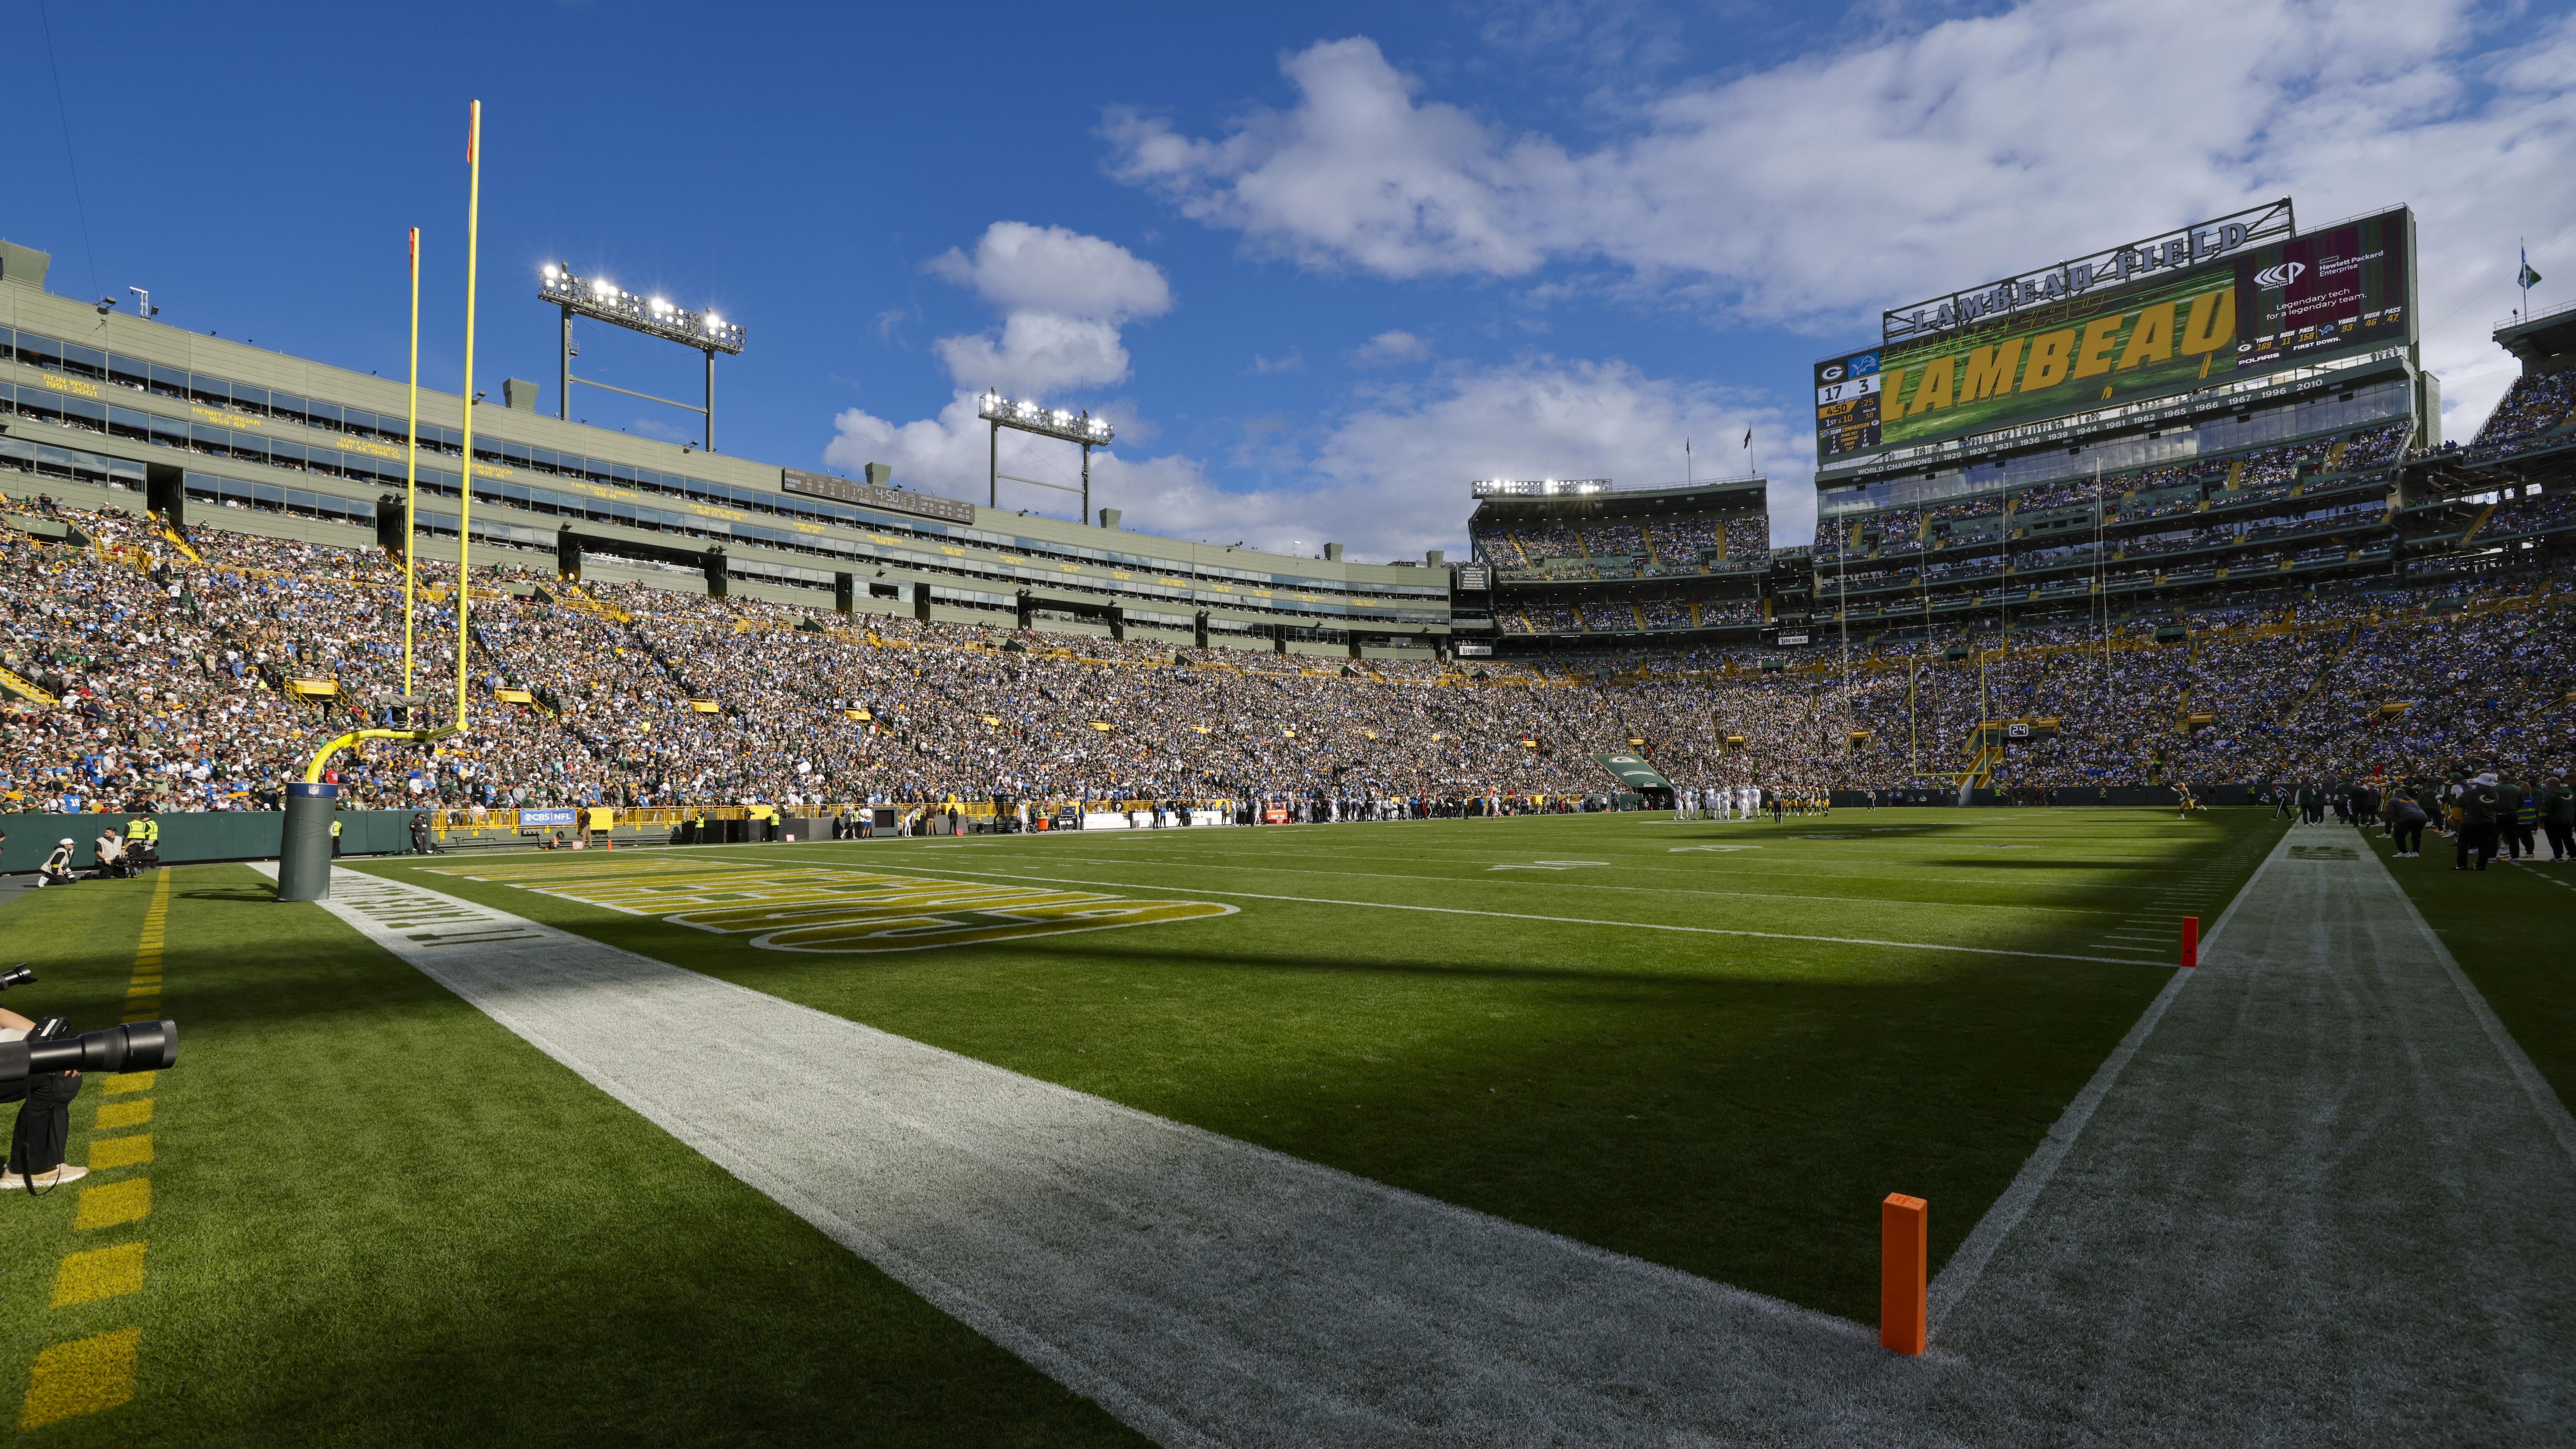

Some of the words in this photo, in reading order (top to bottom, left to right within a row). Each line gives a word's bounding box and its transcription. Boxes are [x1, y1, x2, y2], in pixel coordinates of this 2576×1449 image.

[2319, 259, 2350, 271] Hewlett
[2351, 250, 2383, 263] Packard
[1912, 264, 2093, 334] LAMBEAU
[2114, 223, 2247, 279] FIELD
[2319, 263, 2358, 277] Enterprise
[2277, 293, 2326, 310] Legendary
[2328, 288, 2349, 298] tech
[2289, 299, 2336, 315] legendary
[2339, 294, 2367, 303] team.
[2338, 317, 2358, 325] YARDS
[2342, 324, 2353, 332] 93
[2365, 318, 2377, 327] 46
[2387, 314, 2399, 322] 47
[2256, 335, 2274, 344] YARDS
[2299, 326, 2314, 334] PASS
[2257, 342, 2272, 351] 169
[2298, 333, 2314, 342] 158
[2293, 342, 2314, 350] FIRST
[2316, 337, 2341, 346] DOWN.
[1880, 287, 2236, 422] LAMBEAU
[2238, 353, 2279, 365] POLARIS
[43, 374, 66, 384] RON
[70, 380, 98, 390] WOLF
[1825, 385, 1842, 401] 17
[1859, 379, 1868, 393] 3
[193, 407, 222, 418] HENRY
[225, 414, 260, 425] JORDAN
[1827, 404, 1847, 414] 4:50
[1842, 422, 1870, 432] COMPARISON
[1858, 466, 1884, 475] WORLD
[1887, 457, 1932, 470] CHAMPIONS
[1969, 447, 1988, 455] 1930
[1995, 442, 2012, 450] 1931
[2020, 437, 2040, 446] 1936
[2048, 432, 2067, 440] 1939
[2076, 425, 2097, 434] 1944
[2106, 420, 2125, 429] 1961
[2133, 414, 2155, 423] 1962
[2164, 408, 2186, 418] 1965
[2195, 401, 2218, 411] 1966
[2228, 395, 2251, 405] 1967
[2261, 387, 2286, 398] 1996
[2297, 379, 2323, 391] 2010
[362, 442, 398, 453] CANADEO
[485, 466, 512, 475] HUTSON
[611, 490, 638, 498] LAMBEAU
[854, 488, 862, 497] 17
[876, 488, 899, 502] 4:50
[2012, 726, 2025, 735] 24
[344, 897, 495, 929] TAKES
[503, 869, 1241, 953] GREEN
[405, 928, 544, 947] IT
